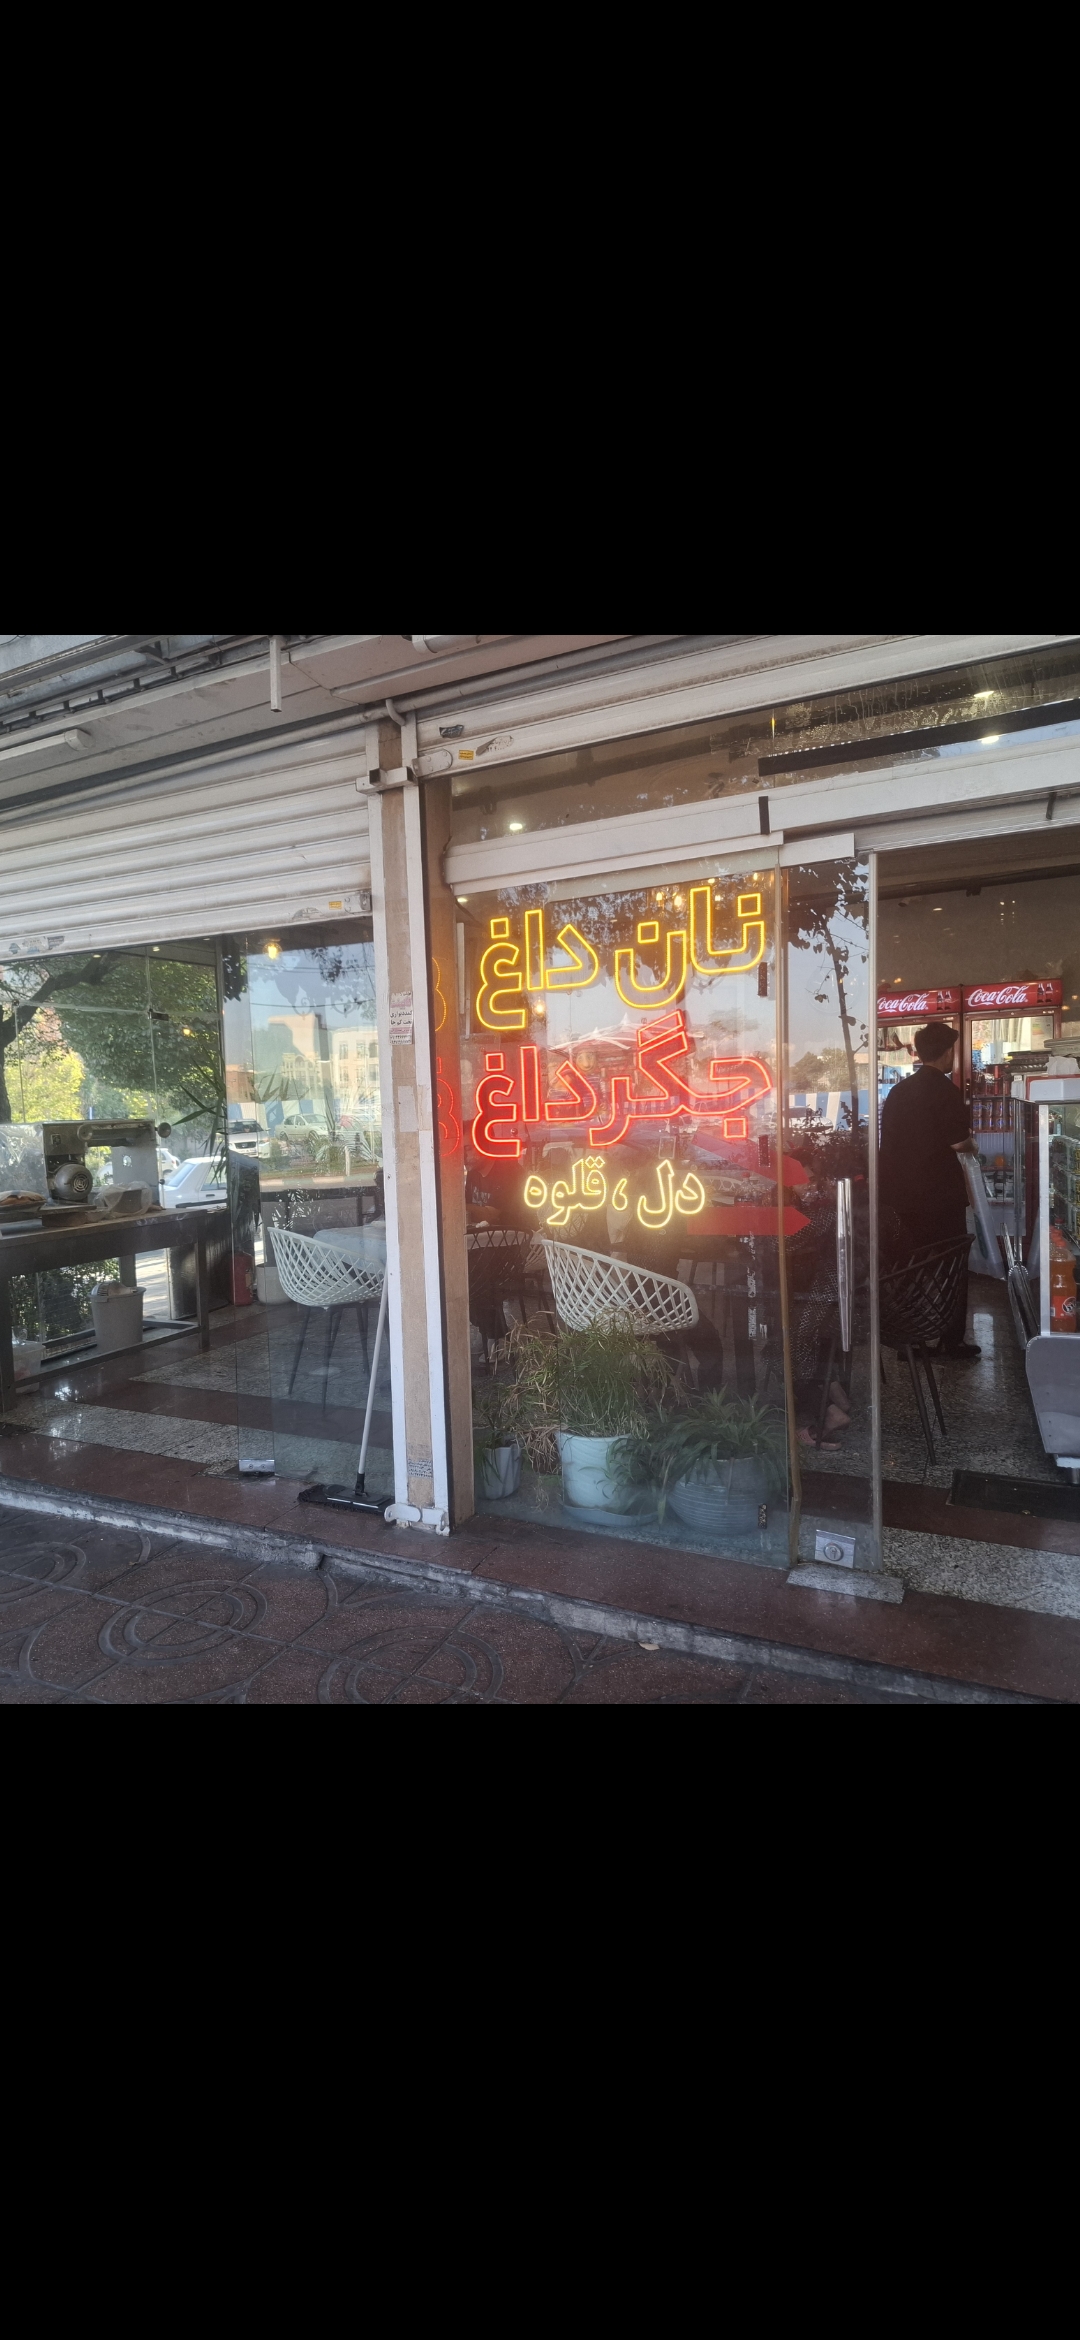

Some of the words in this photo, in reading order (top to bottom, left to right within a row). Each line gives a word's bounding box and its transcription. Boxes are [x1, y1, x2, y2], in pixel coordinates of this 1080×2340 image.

[475, 908, 599, 1031] داغ
[615, 886, 765, 1009] نان
[968, 985, 1029, 1006] Coca-Cola
